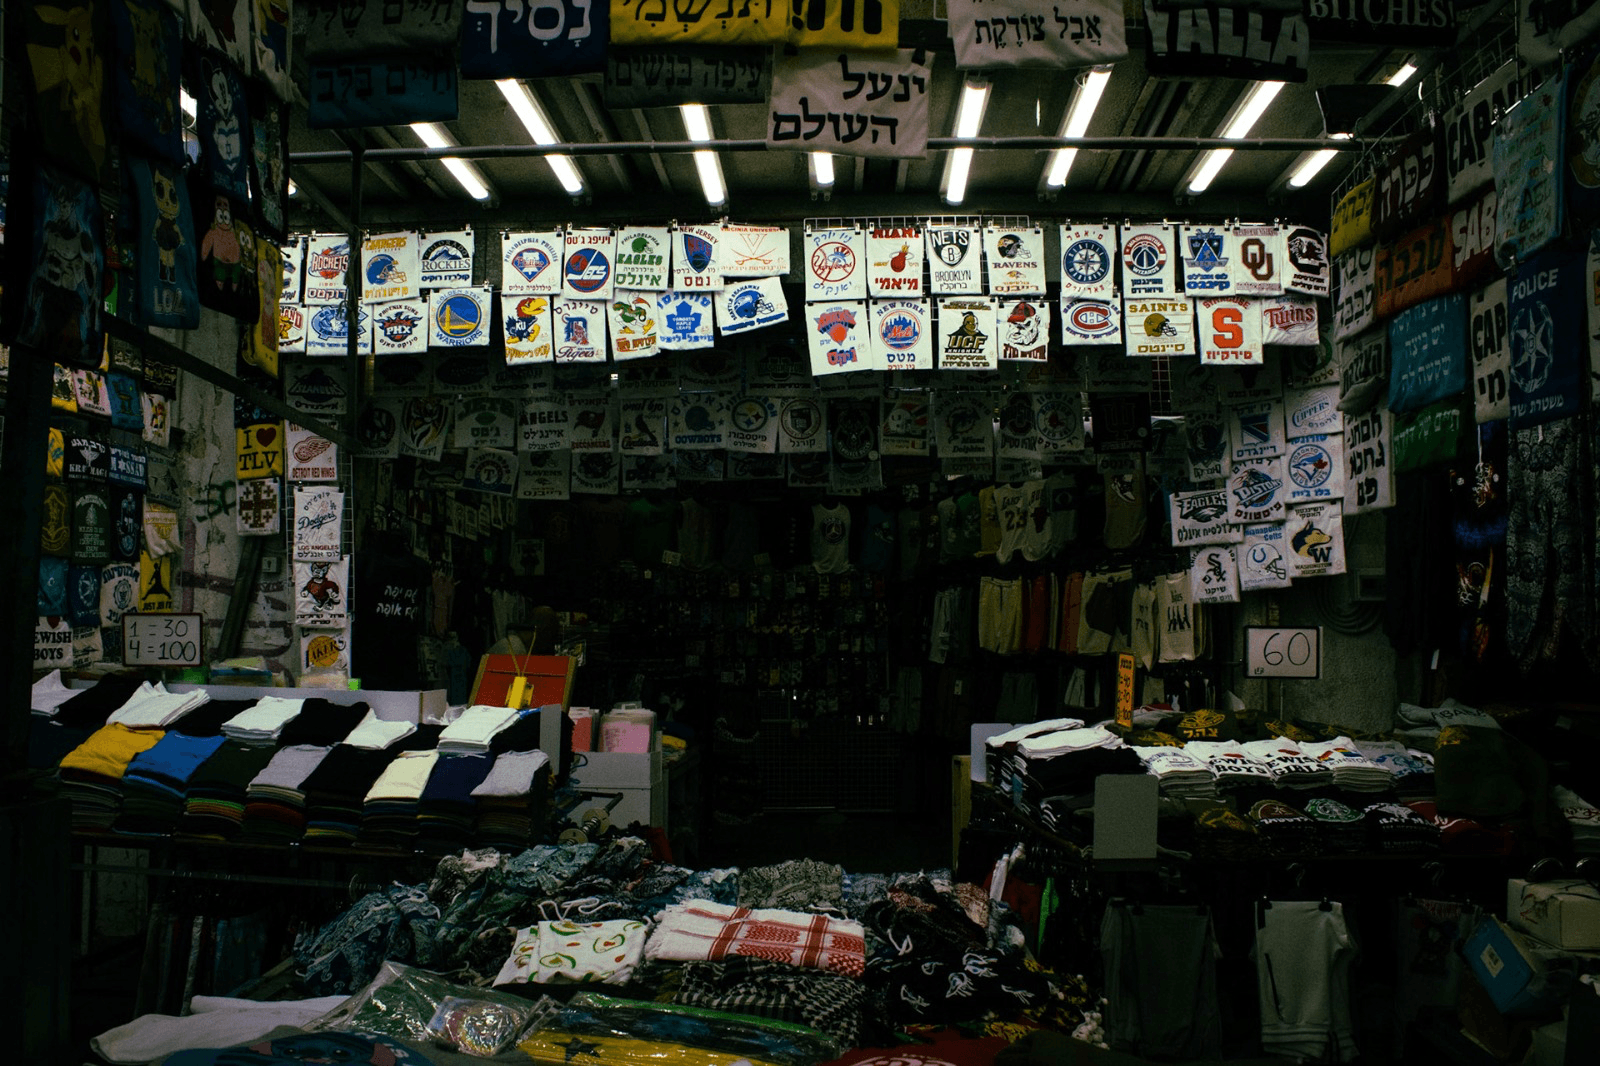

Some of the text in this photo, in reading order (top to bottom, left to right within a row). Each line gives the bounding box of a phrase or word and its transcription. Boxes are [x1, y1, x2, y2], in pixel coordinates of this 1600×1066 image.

[974, 7, 1102, 48] אבל צודקת
[838, 54, 925, 102] ינעל
[773, 98, 898, 145] העולם
[621, 233, 659, 246] PHILADELPHIA
[695, 229, 719, 244] JERSEY
[931, 230, 969, 248] NETS
[311, 252, 350, 272] ROCKETS
[617, 253, 664, 265] EAGLES
[947, 247, 955, 262] B
[421, 259, 472, 271] ROCKIES
[992, 261, 1038, 269] RAVENS
[616, 272, 662, 286] איגלס
[684, 276, 711, 286] נטס
[935, 270, 972, 281] BROOKLYN
[875, 277, 919, 290] מיאמי
[940, 282, 968, 291] ברוקלין
[1512, 268, 1559, 303] POLICE
[404, 305, 419, 315] SUNS
[876, 302, 926, 316] NEW YORK
[1128, 303, 1188, 313] SAINTS
[1263, 305, 1315, 331] Twins
[386, 325, 411, 335] PHX
[1212, 307, 1244, 349] S
[436, 329, 483, 347] WARRIORS
[949, 335, 989, 348] UCF
[556, 345, 595, 361] Tigers
[1138, 343, 1186, 353] סיינטס
[1206, 350, 1253, 360] סירקיוז
[886, 352, 916, 363] מטס
[1530, 394, 1565, 413] משטרת
[519, 411, 569, 426] ANGELS
[243, 430, 252, 449] I
[675, 434, 722, 444] COWBOYS
[239, 451, 279, 471] TLV
[292, 467, 335, 478] DETROIT RED WINGS
[1181, 490, 1227, 508] EAGLES
[298, 513, 338, 530] Dodgers
[1311, 547, 1332, 562] W
[1294, 562, 1333, 570] WASHINGTON
[130, 622, 138, 637] 1
[164, 619, 188, 637] 30
[130, 640, 140, 659] 4
[158, 641, 197, 661] 100
[1263, 632, 1311, 666] 60
[1272, 763, 1331, 777] GIRLS
